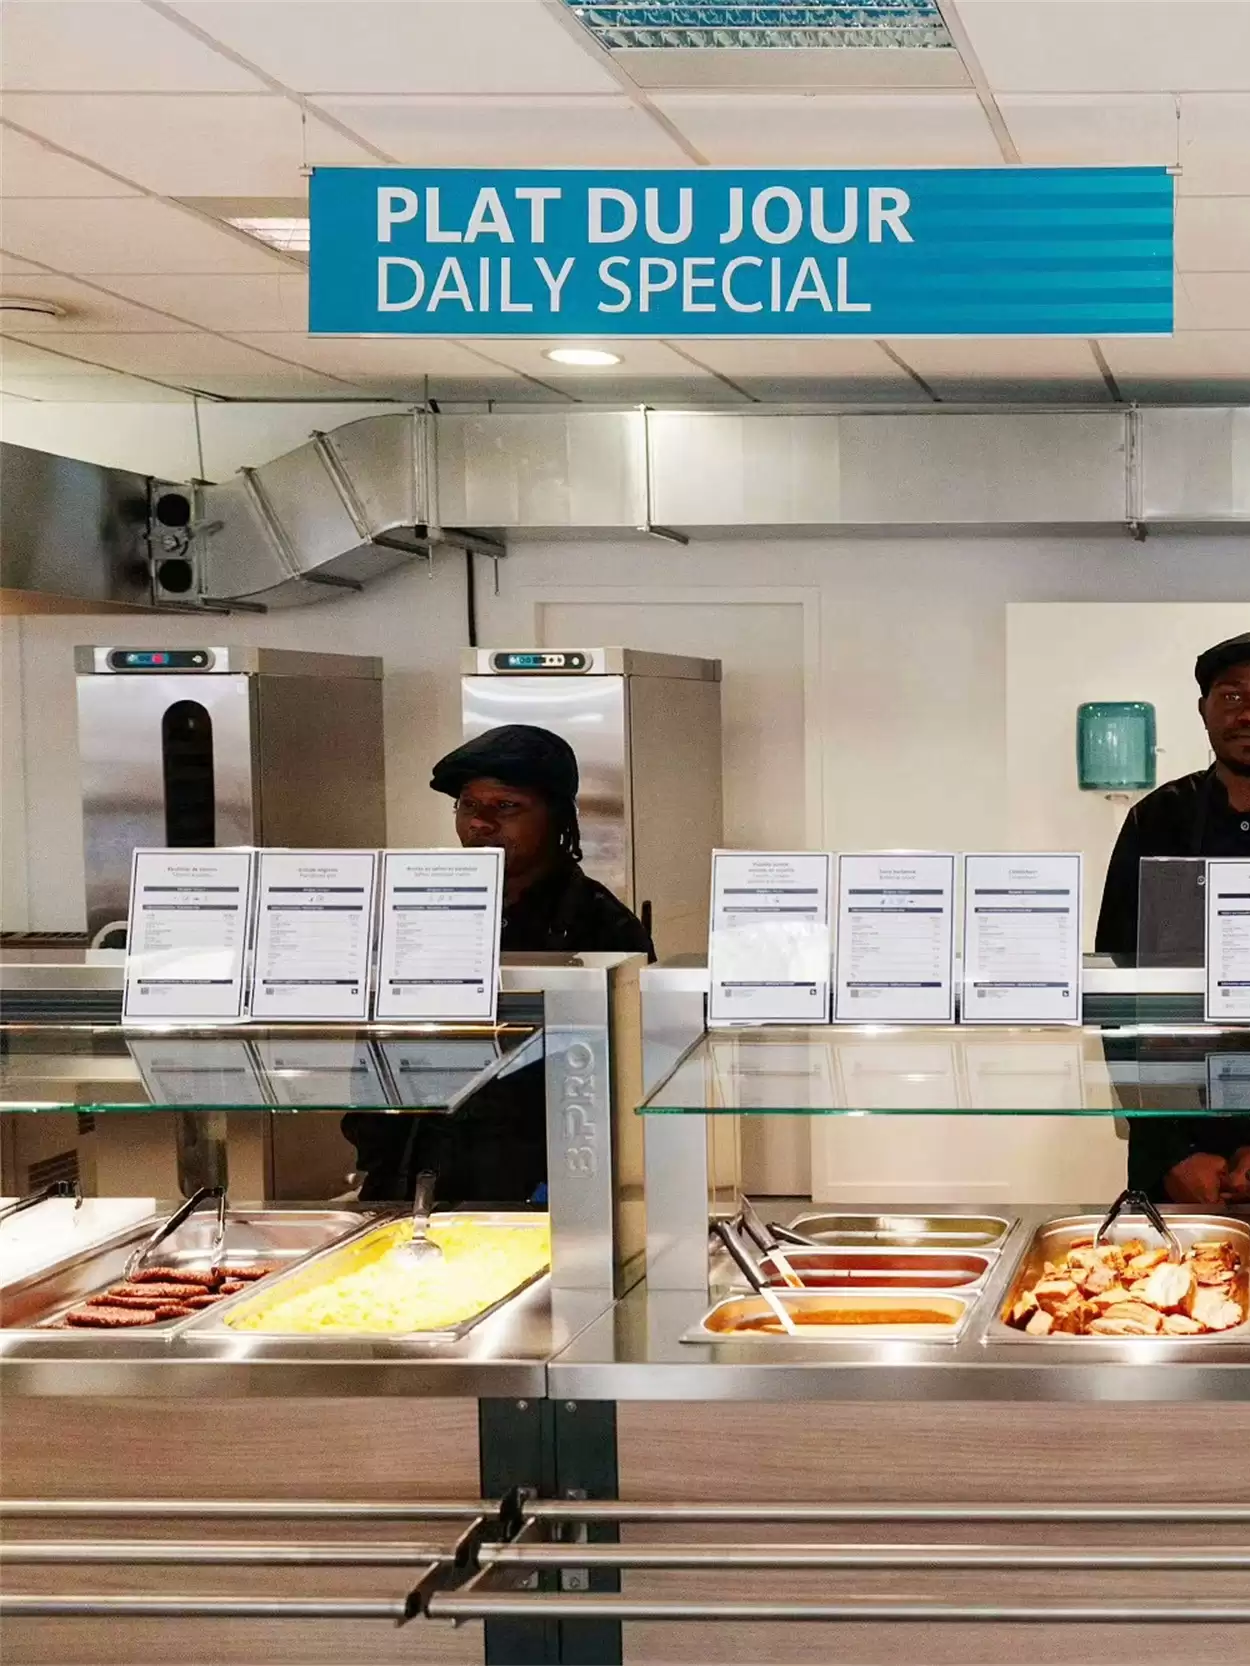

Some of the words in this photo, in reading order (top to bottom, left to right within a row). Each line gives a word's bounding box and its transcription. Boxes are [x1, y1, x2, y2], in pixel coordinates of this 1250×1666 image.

[376, 187, 562, 243] PLAT
[588, 187, 693, 245] DU
[718, 186, 914, 245] JOUR
[377, 256, 575, 312] DAILY
[598, 255, 872, 313] SPECIAL
